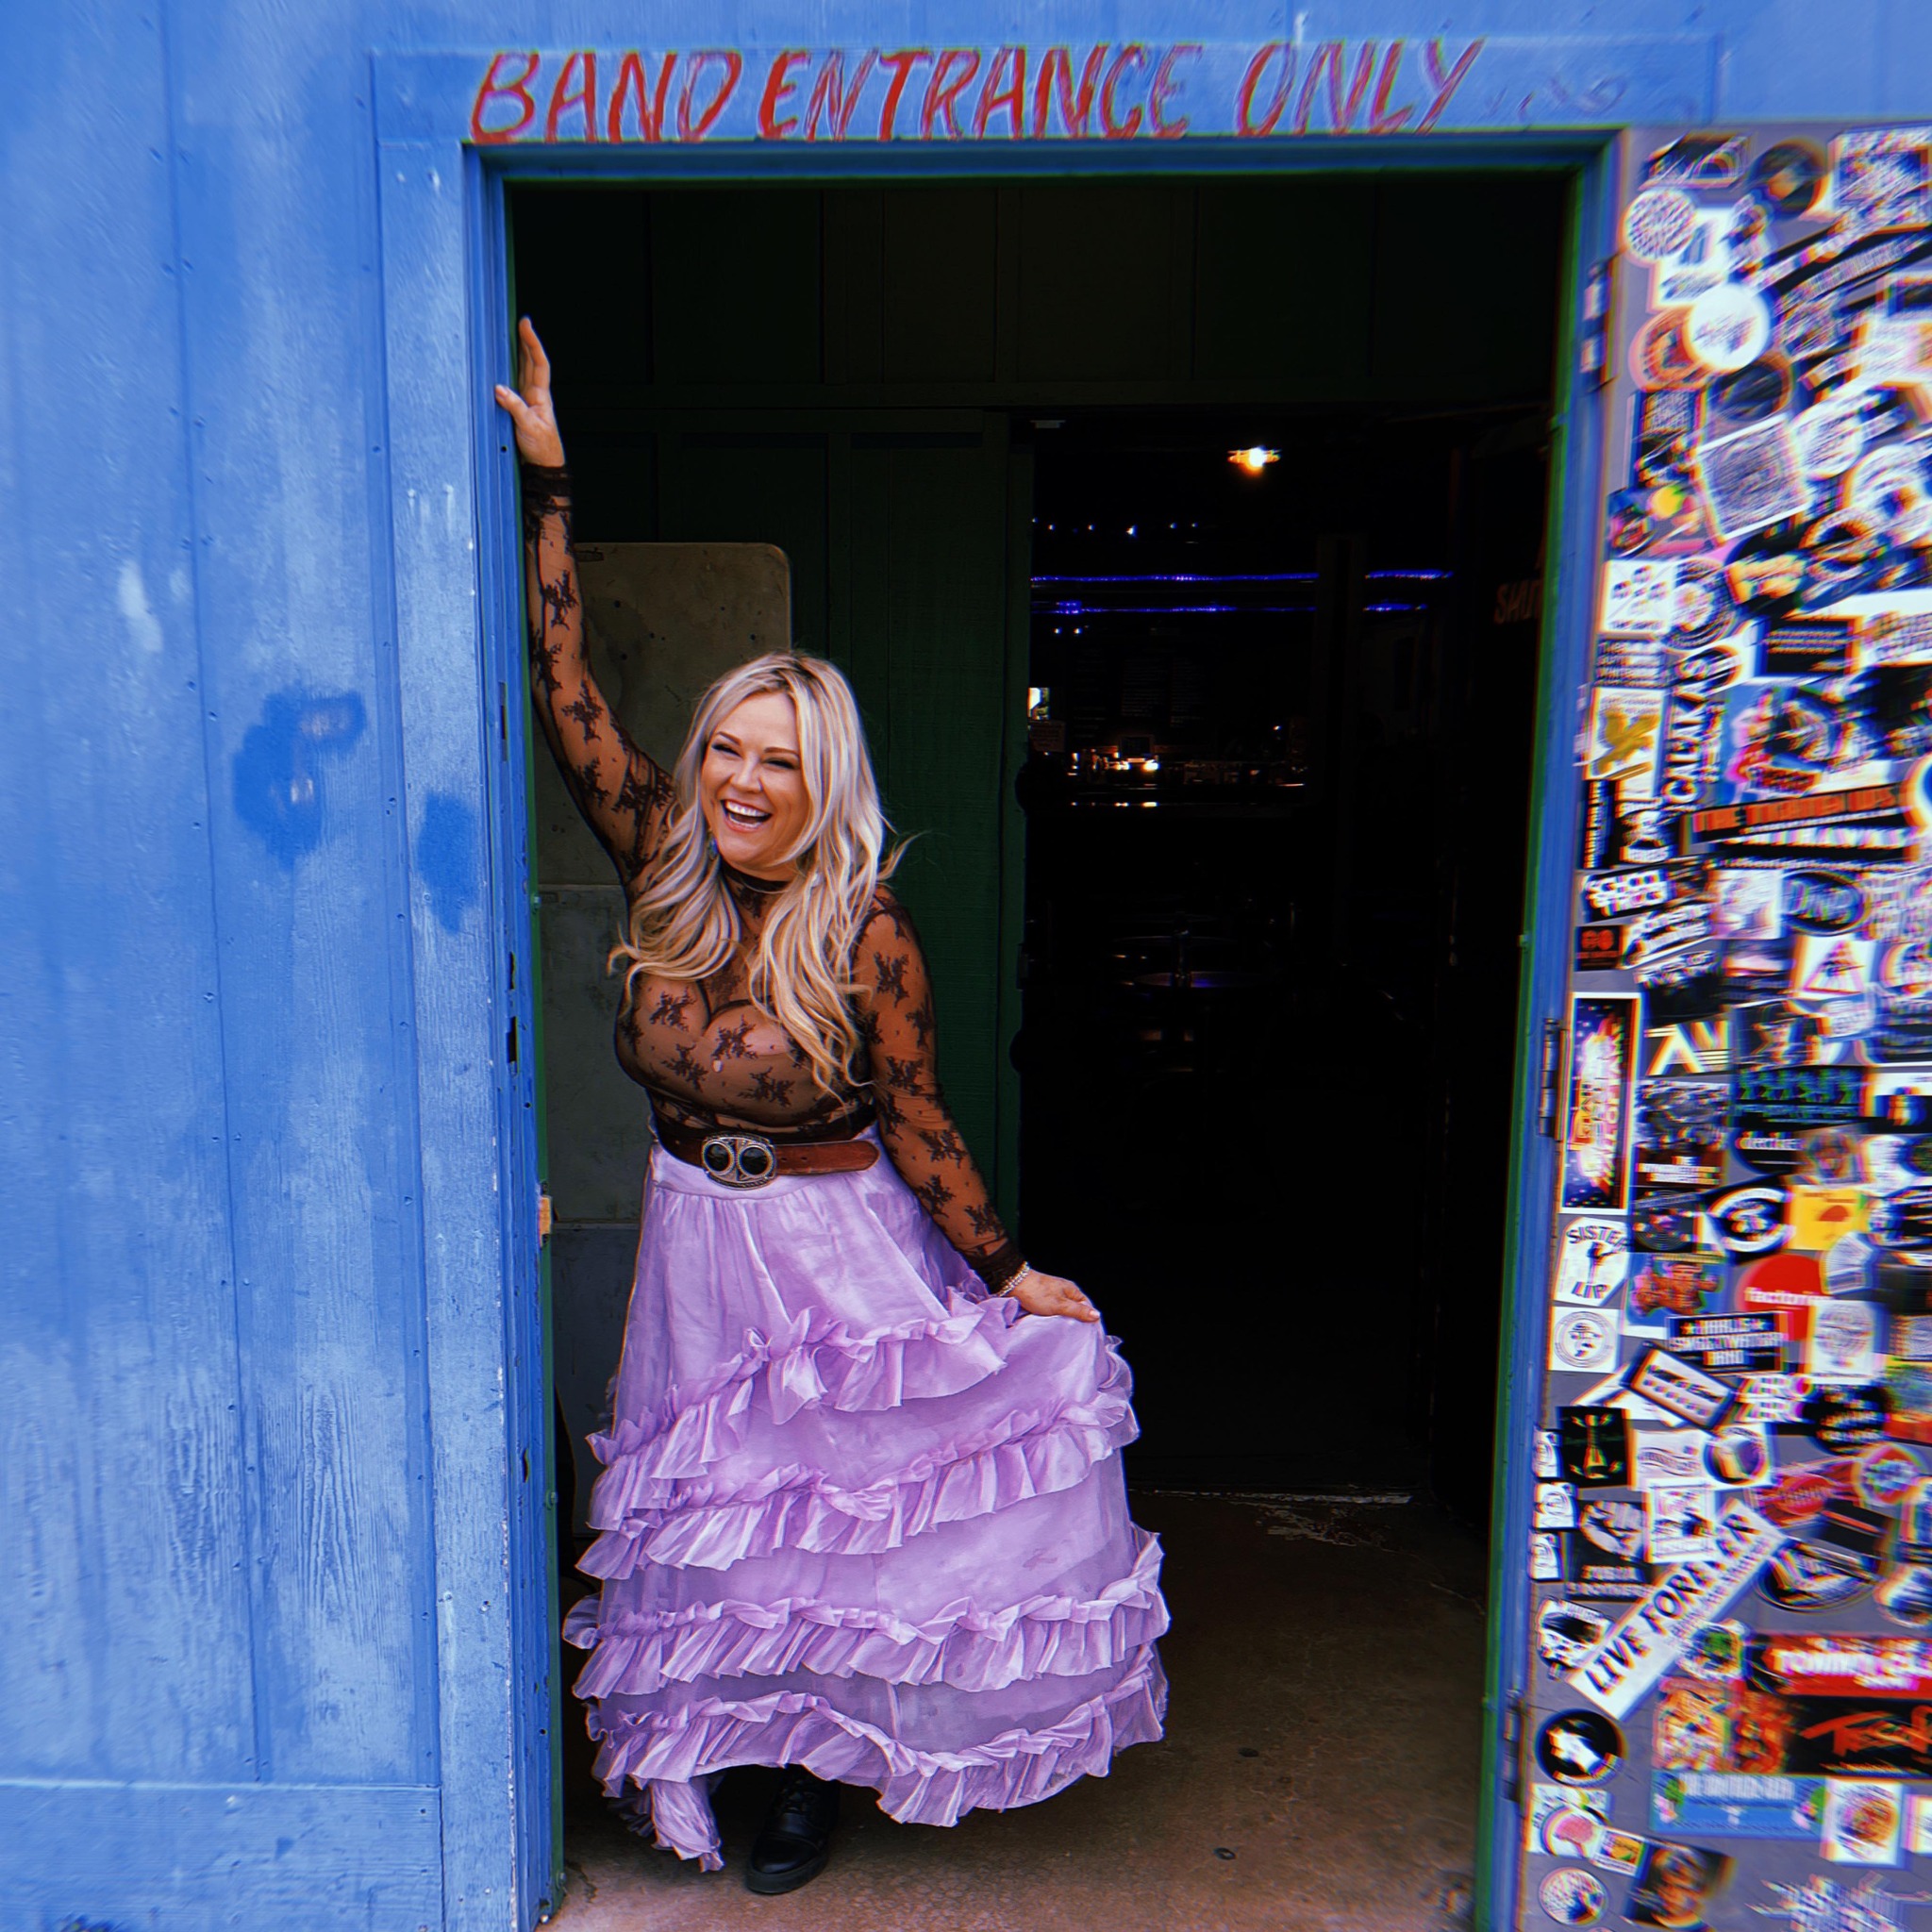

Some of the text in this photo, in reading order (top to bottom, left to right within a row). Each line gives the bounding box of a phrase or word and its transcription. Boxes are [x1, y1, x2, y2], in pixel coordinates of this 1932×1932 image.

[469, 35, 1488, 143] BAND ENTRANCE ONLY
[1566, 1225, 1630, 1252] SISTER
[1571, 1280, 1609, 1299] LIP
[1581, 1625, 1652, 1695] LIVE
[1635, 1510, 1761, 1637] FOREER
